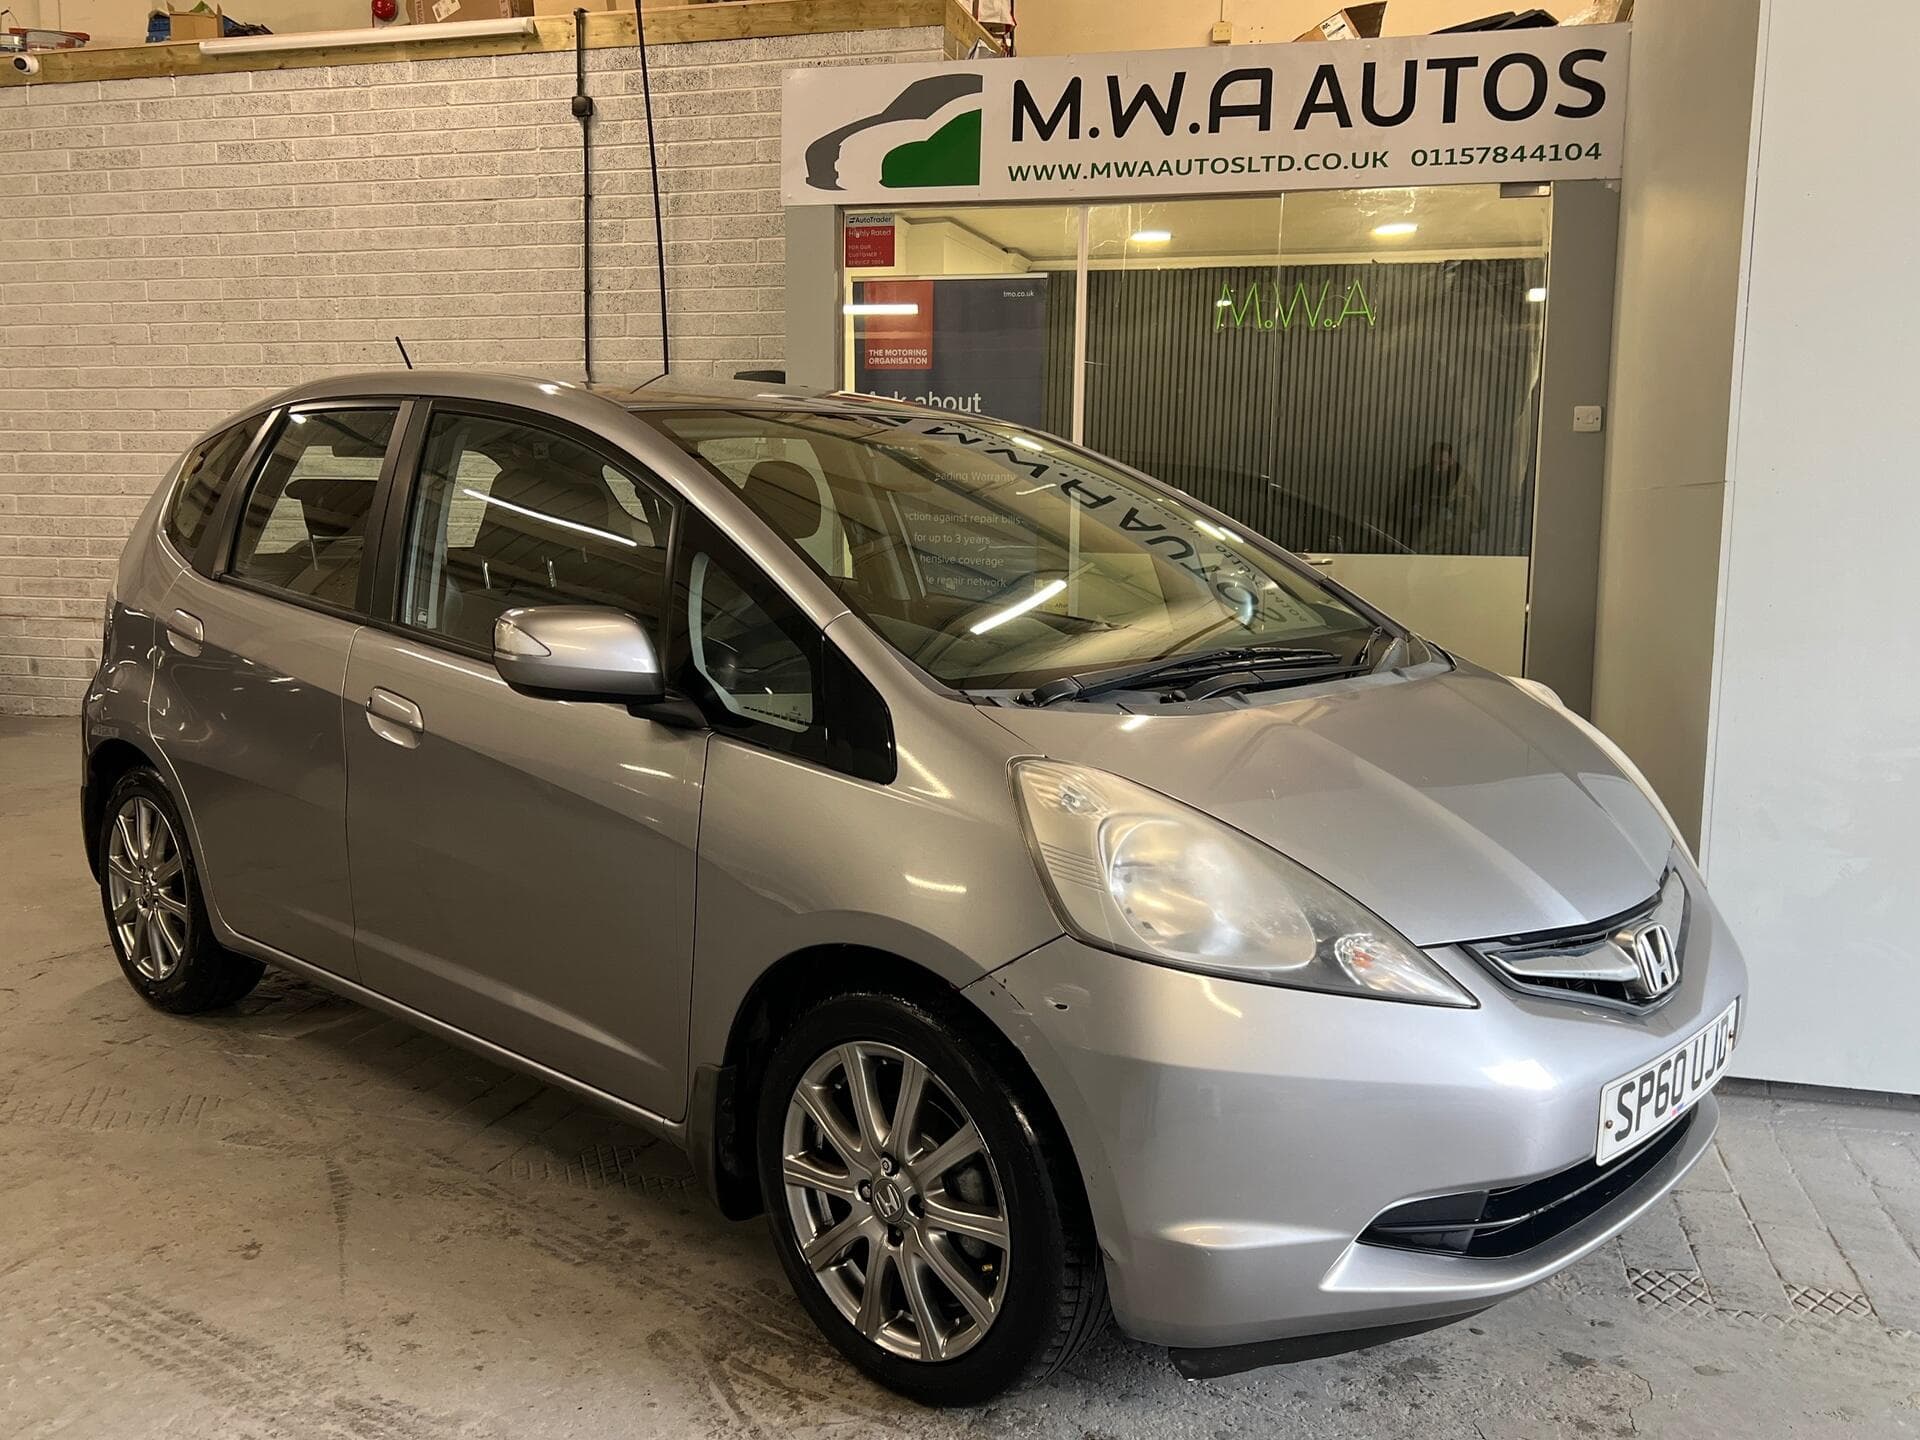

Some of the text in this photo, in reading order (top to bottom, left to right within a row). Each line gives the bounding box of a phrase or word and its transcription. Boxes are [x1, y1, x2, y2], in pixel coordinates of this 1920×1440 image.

[1012, 48, 1607, 142] M.W.A AUTOS
[1008, 142, 1602, 182] WWW.MWAAUTOSLTD.CO.UK 01157844104
[854, 216, 891, 224] AutoTrader
[1003, 290, 1034, 299] tmo.co.uk
[1216, 279, 1375, 330] M.W.A
[869, 349, 928, 358] THE MOTORING
[868, 357, 928, 366] ORGANISATION
[933, 512, 968, 525] against
[970, 514, 998, 526] repair
[914, 531, 926, 543] for
[929, 535, 941, 545] up
[943, 534, 953, 543] to
[958, 557, 1005, 569] coverage
[967, 577, 1007, 588] network
[1615, 1014, 1730, 1142] SP60 UJD
